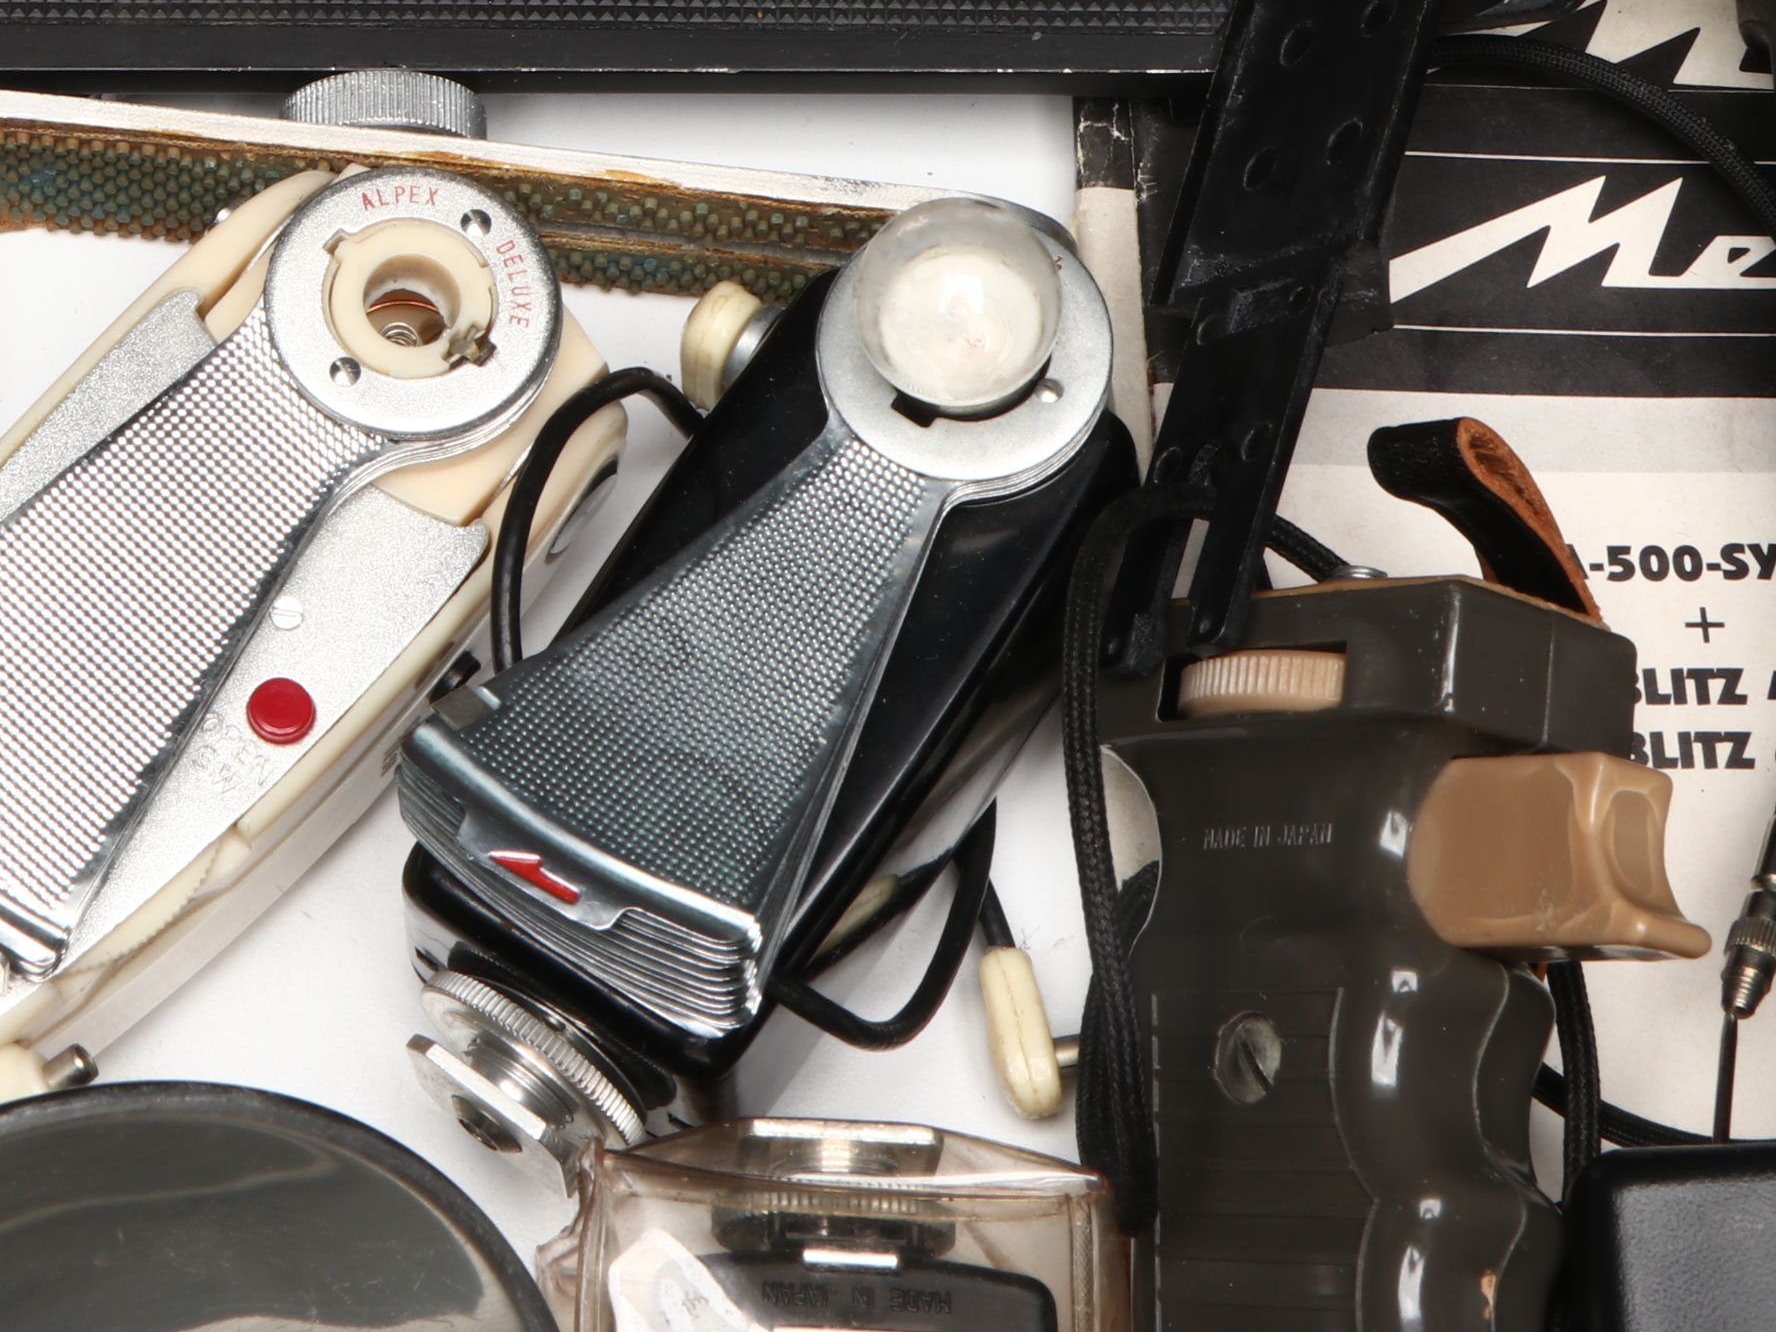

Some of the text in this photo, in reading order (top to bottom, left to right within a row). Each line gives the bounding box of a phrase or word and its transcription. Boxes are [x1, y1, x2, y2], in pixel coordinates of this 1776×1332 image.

[360, 184, 440, 212] ALPEX
[495, 238, 535, 329] DELUXE
[1633, 668, 1749, 706] LITZ
[1202, 821, 1334, 851] MADE IN JAPAN
[761, 1278, 953, 1315] MADE IN JAPAN
